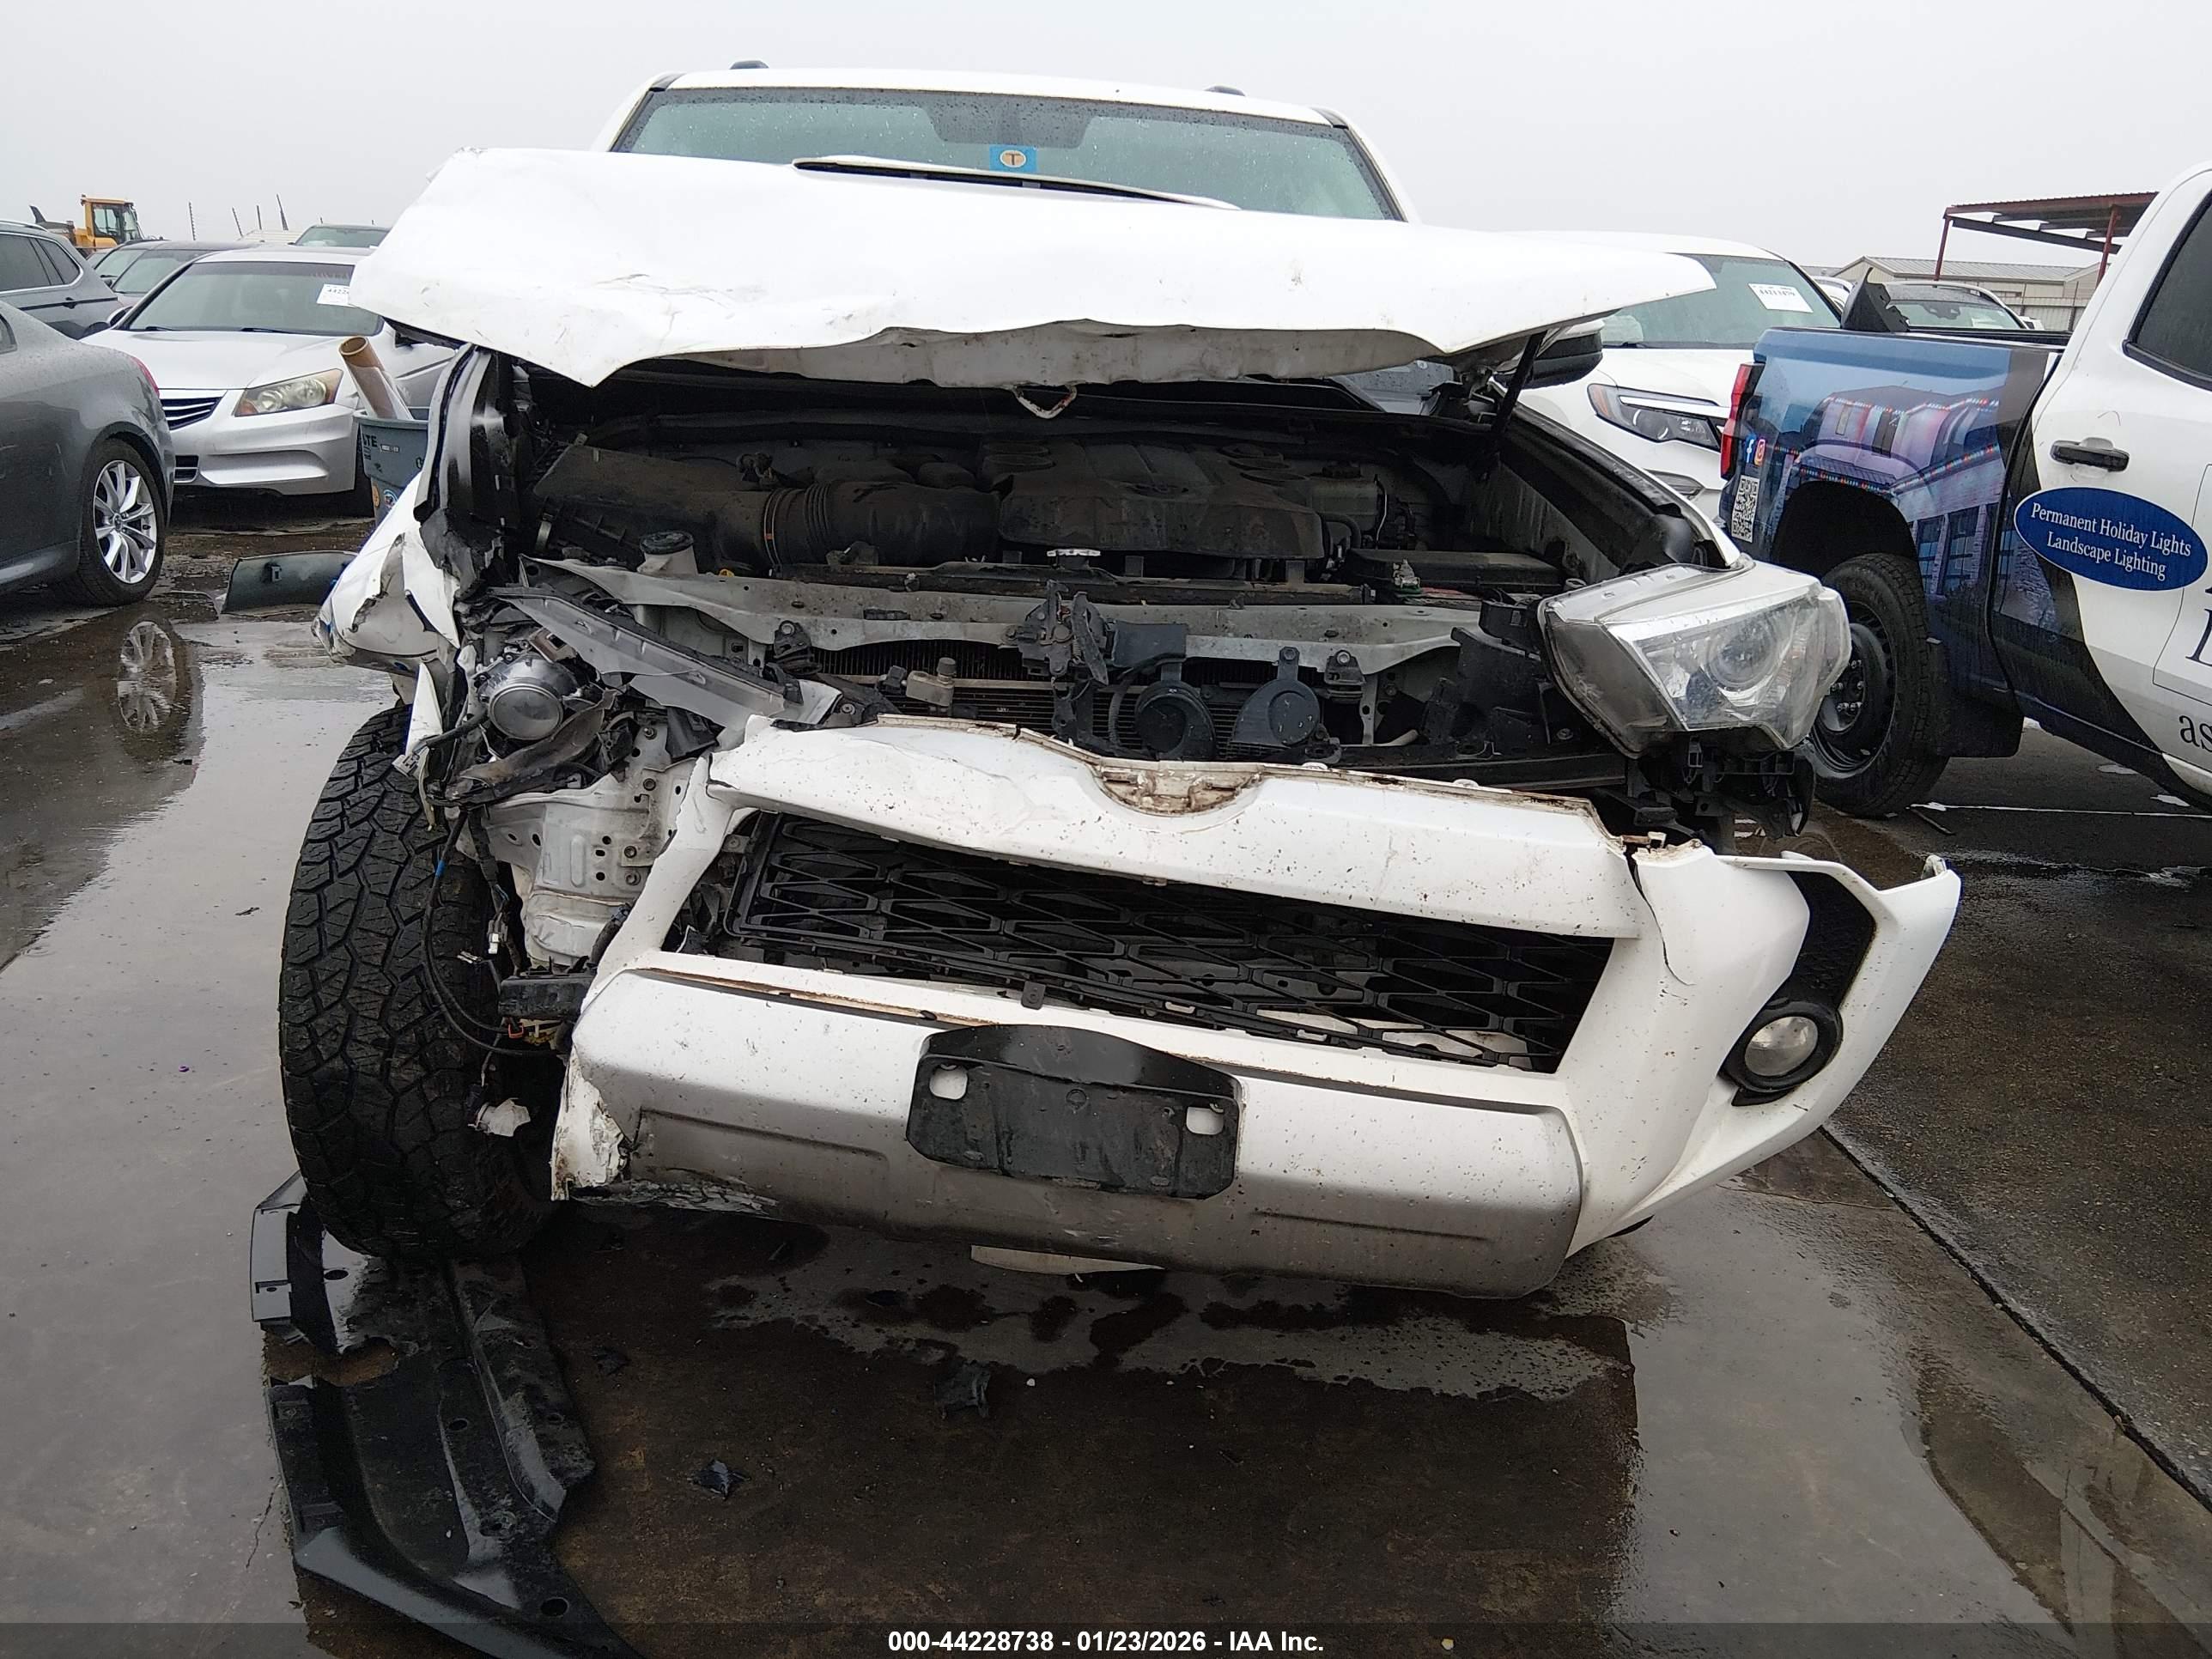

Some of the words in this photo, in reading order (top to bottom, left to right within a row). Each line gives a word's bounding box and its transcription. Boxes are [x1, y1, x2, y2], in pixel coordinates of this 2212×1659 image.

[2031, 502, 2098, 533] Permanent
[2100, 518, 2148, 549] Holiday
[2150, 531, 2191, 556] Lights
[2047, 531, 2112, 564] Landscape
[2114, 548, 2166, 581] Lighting
